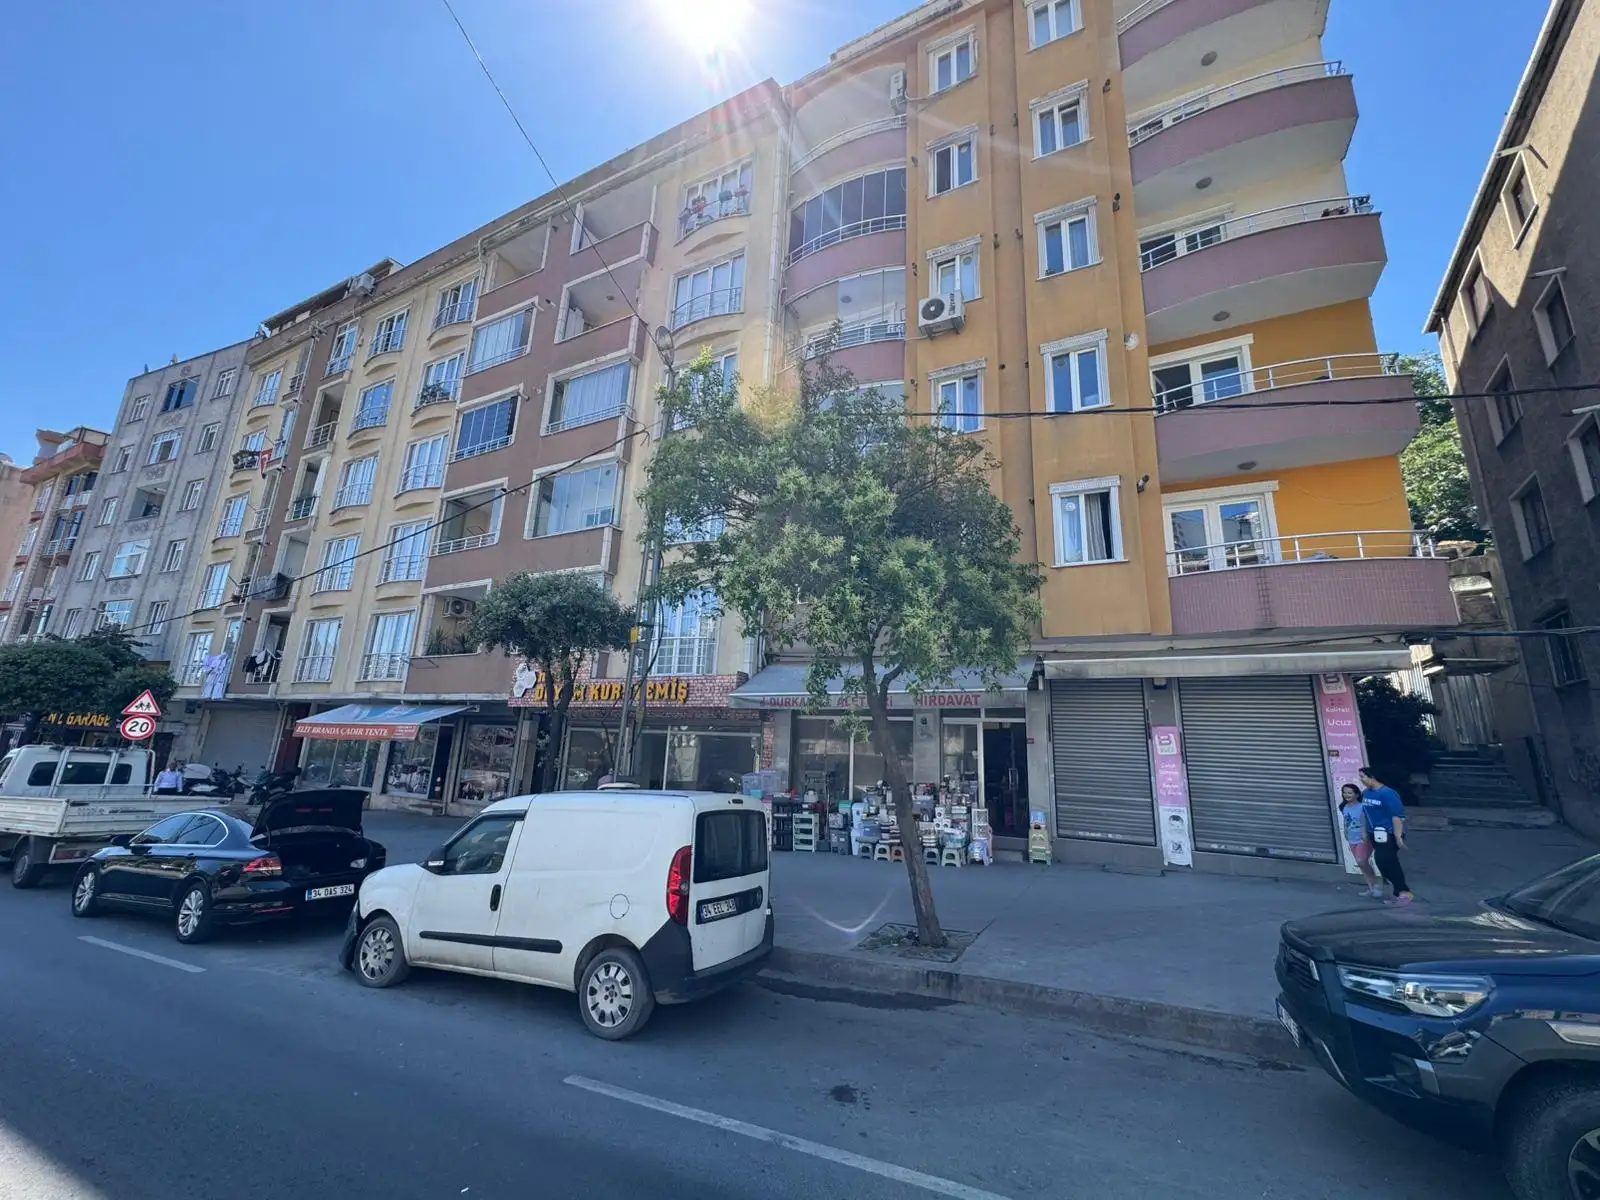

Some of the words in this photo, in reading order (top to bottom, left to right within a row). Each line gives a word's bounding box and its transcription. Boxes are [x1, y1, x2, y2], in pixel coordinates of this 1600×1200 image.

[65, 711, 111, 728] GARAGE
[1327, 718, 1353, 727] Ucuz
[128, 720, 150, 733] 20
[364, 728, 389, 737] TENTE
[312, 888, 322, 898] 34
